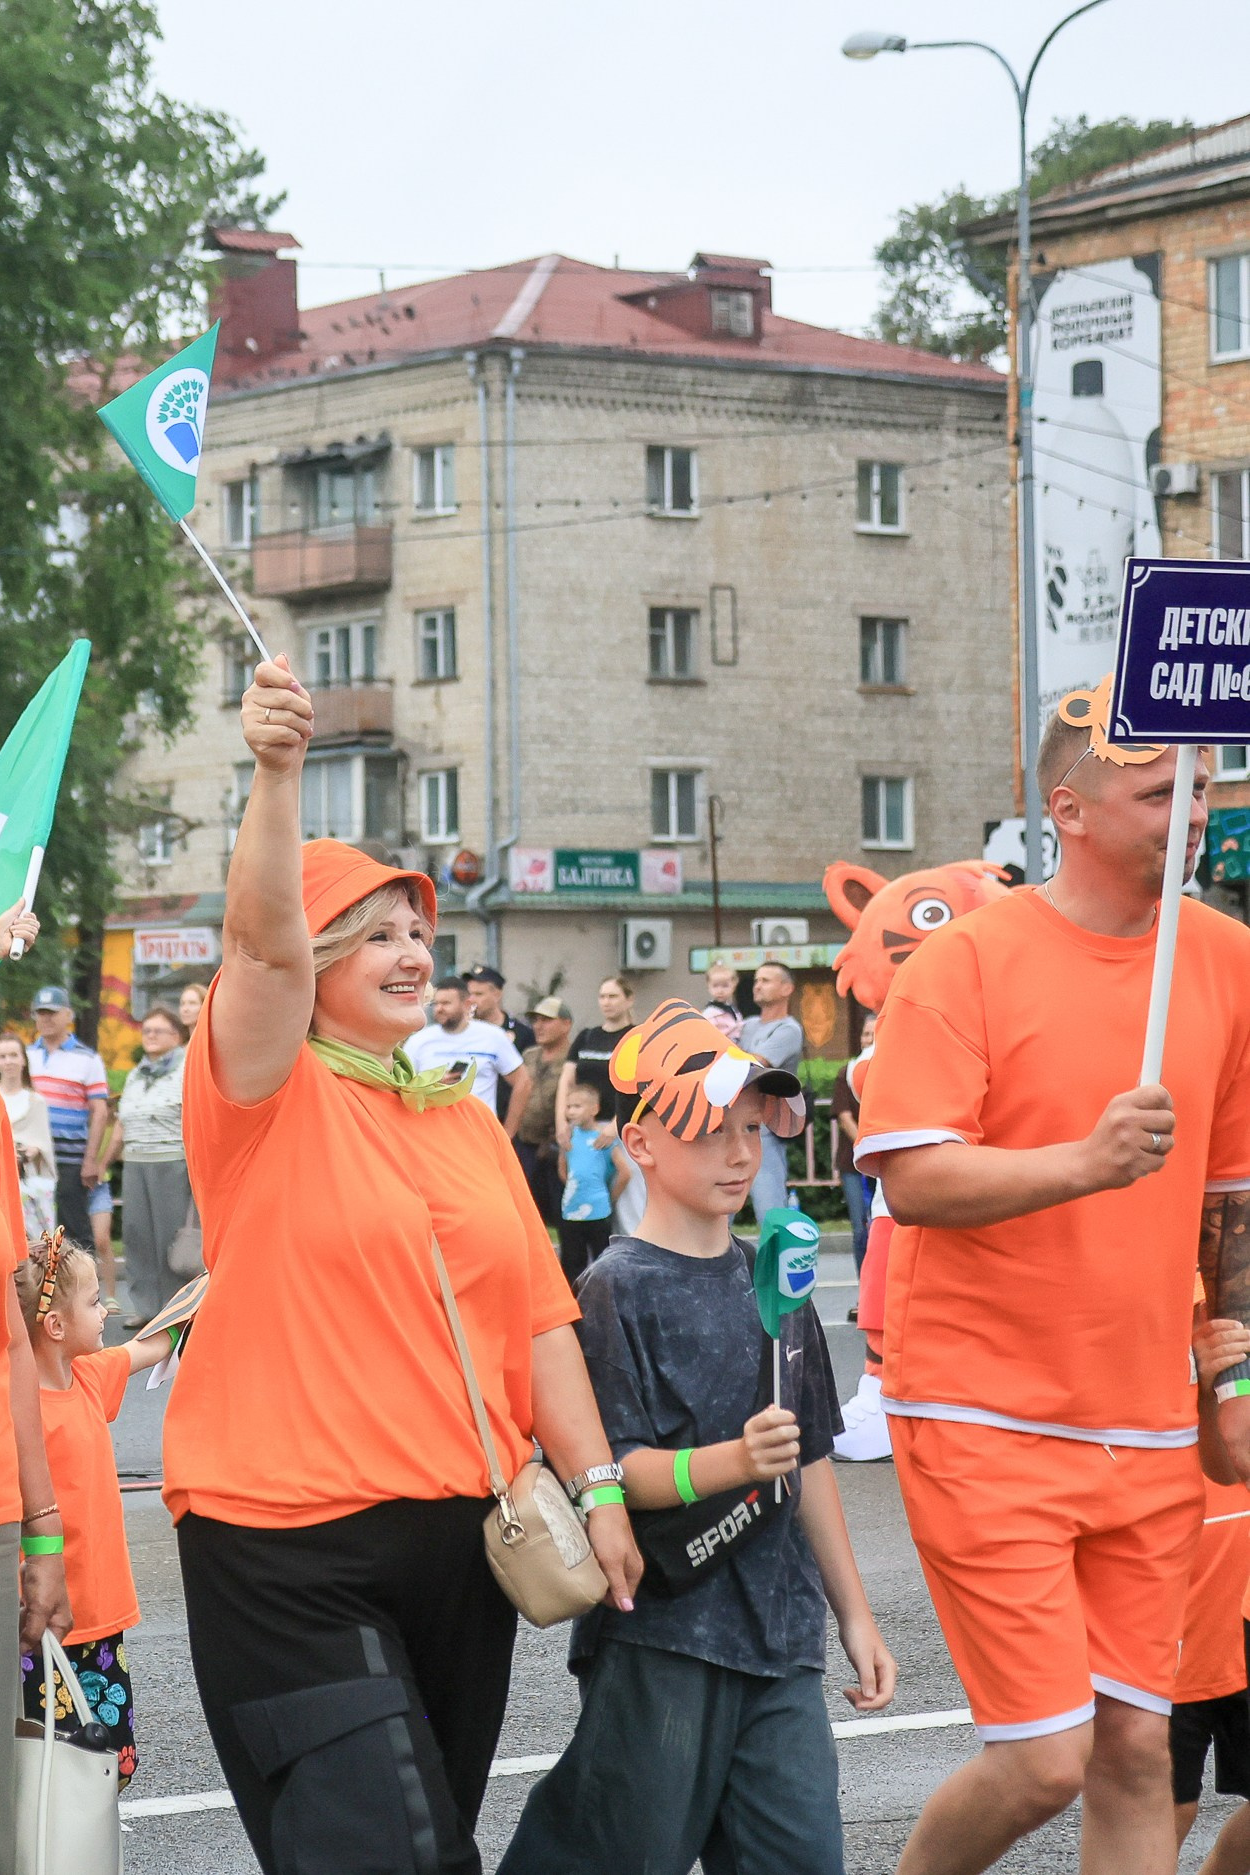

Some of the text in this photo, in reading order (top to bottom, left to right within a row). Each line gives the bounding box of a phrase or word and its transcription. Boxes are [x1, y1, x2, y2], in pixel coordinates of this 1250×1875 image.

[1150, 661, 1205, 707] САД
[558, 866, 636, 887] БАЛТИКА
[686, 1489, 761, 1567] SPORT
